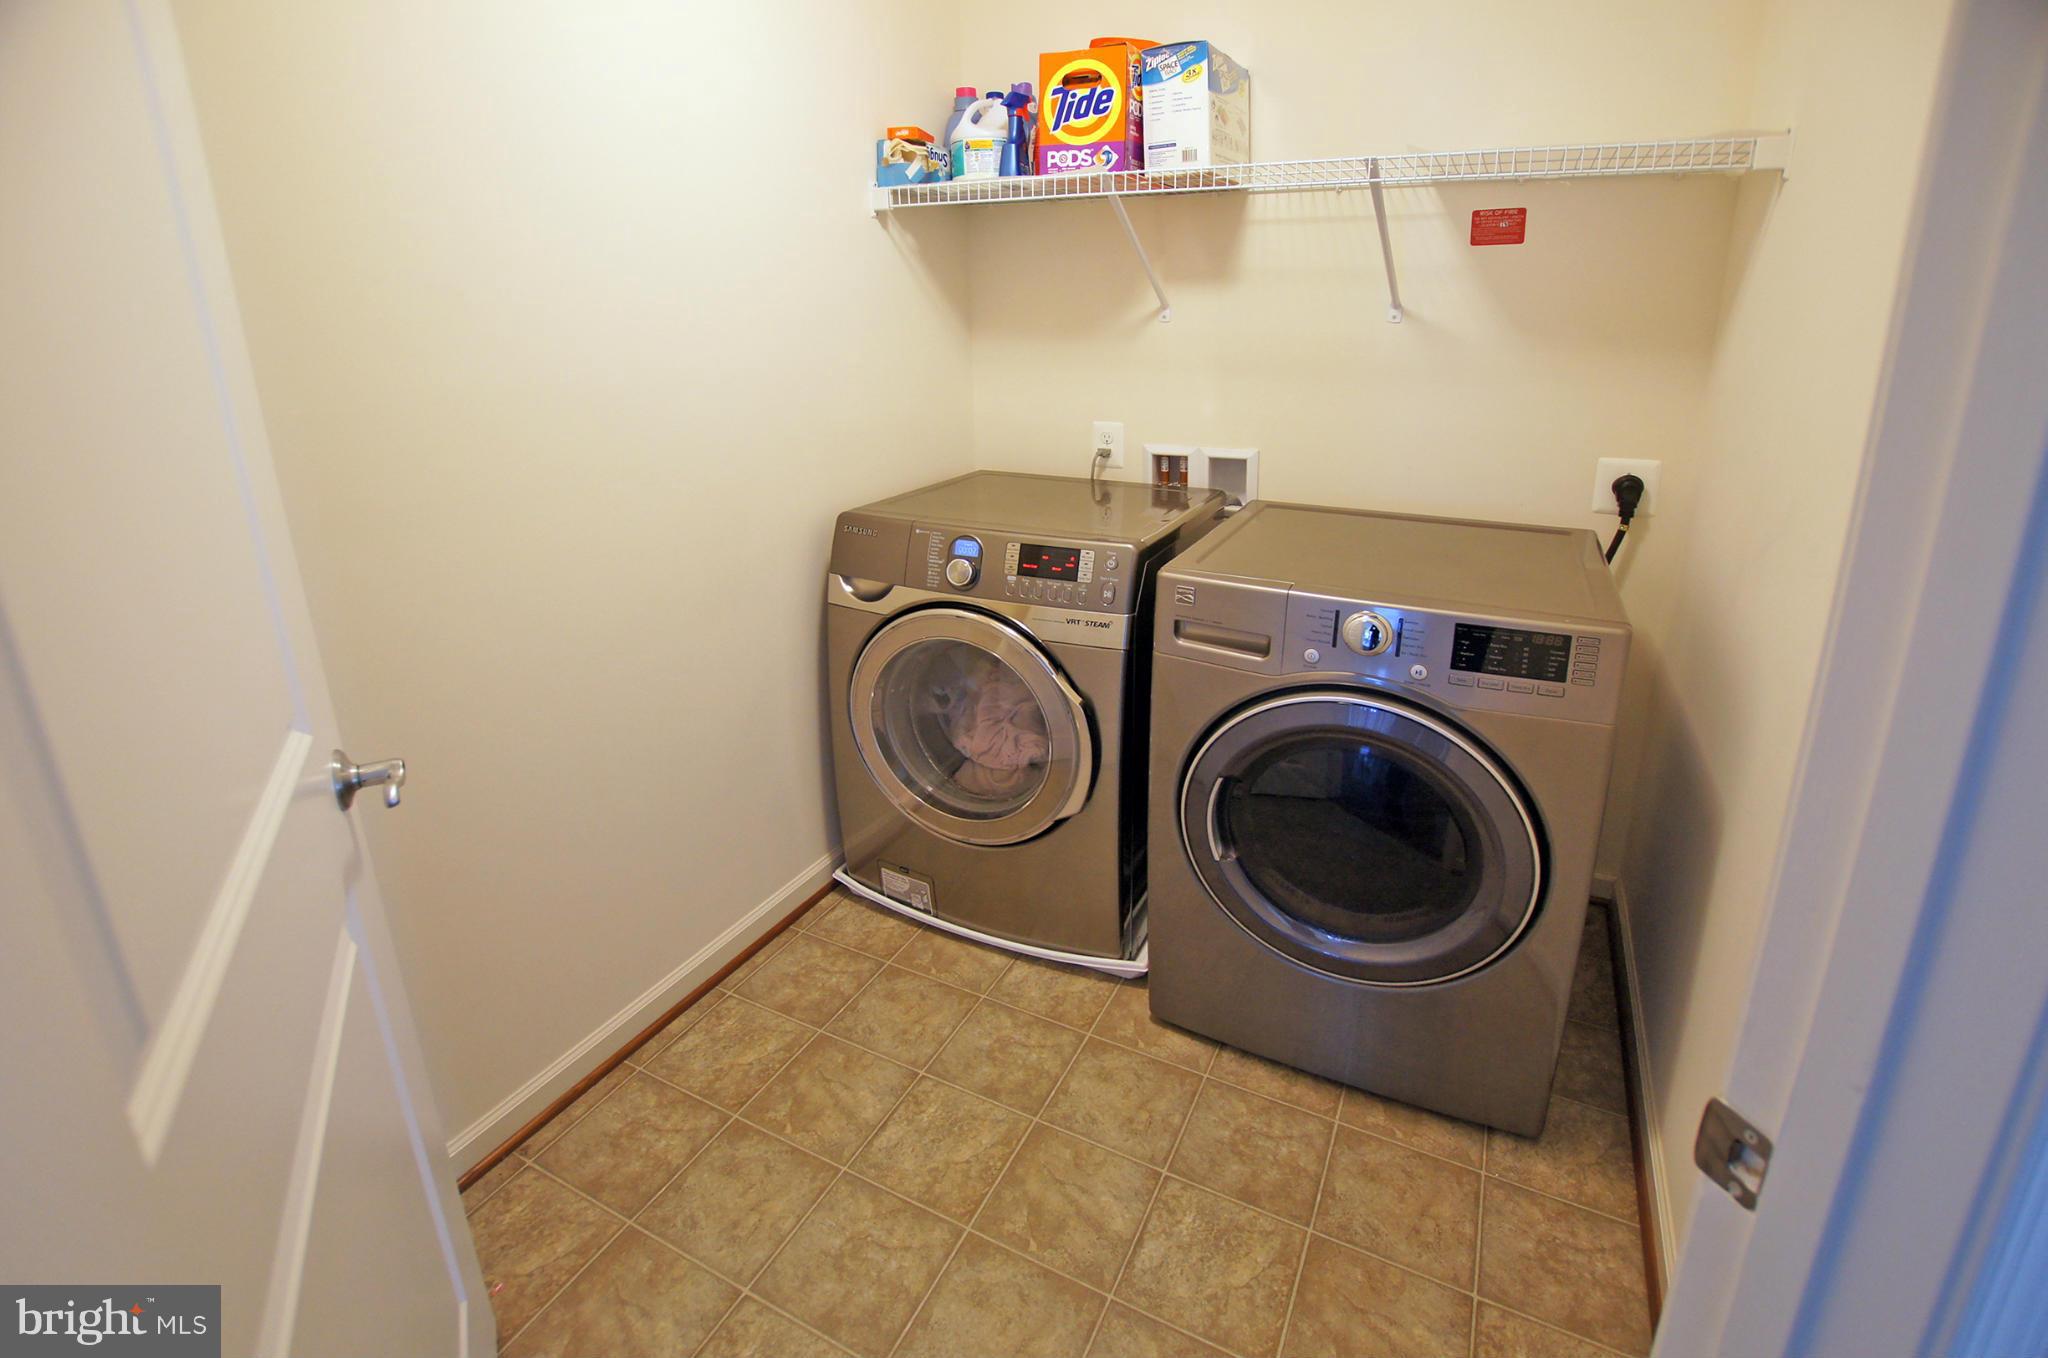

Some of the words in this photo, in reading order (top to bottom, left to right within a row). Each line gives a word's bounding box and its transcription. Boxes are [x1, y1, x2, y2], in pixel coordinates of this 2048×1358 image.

[1159, 60, 1179, 71] SPACE
[1050, 85, 1115, 133] Tide
[1047, 148, 1092, 168] PODS
[844, 525, 879, 537] SAMSUNG
[1065, 618, 1081, 626] VRT
[1084, 619, 1110, 629] STEAM
